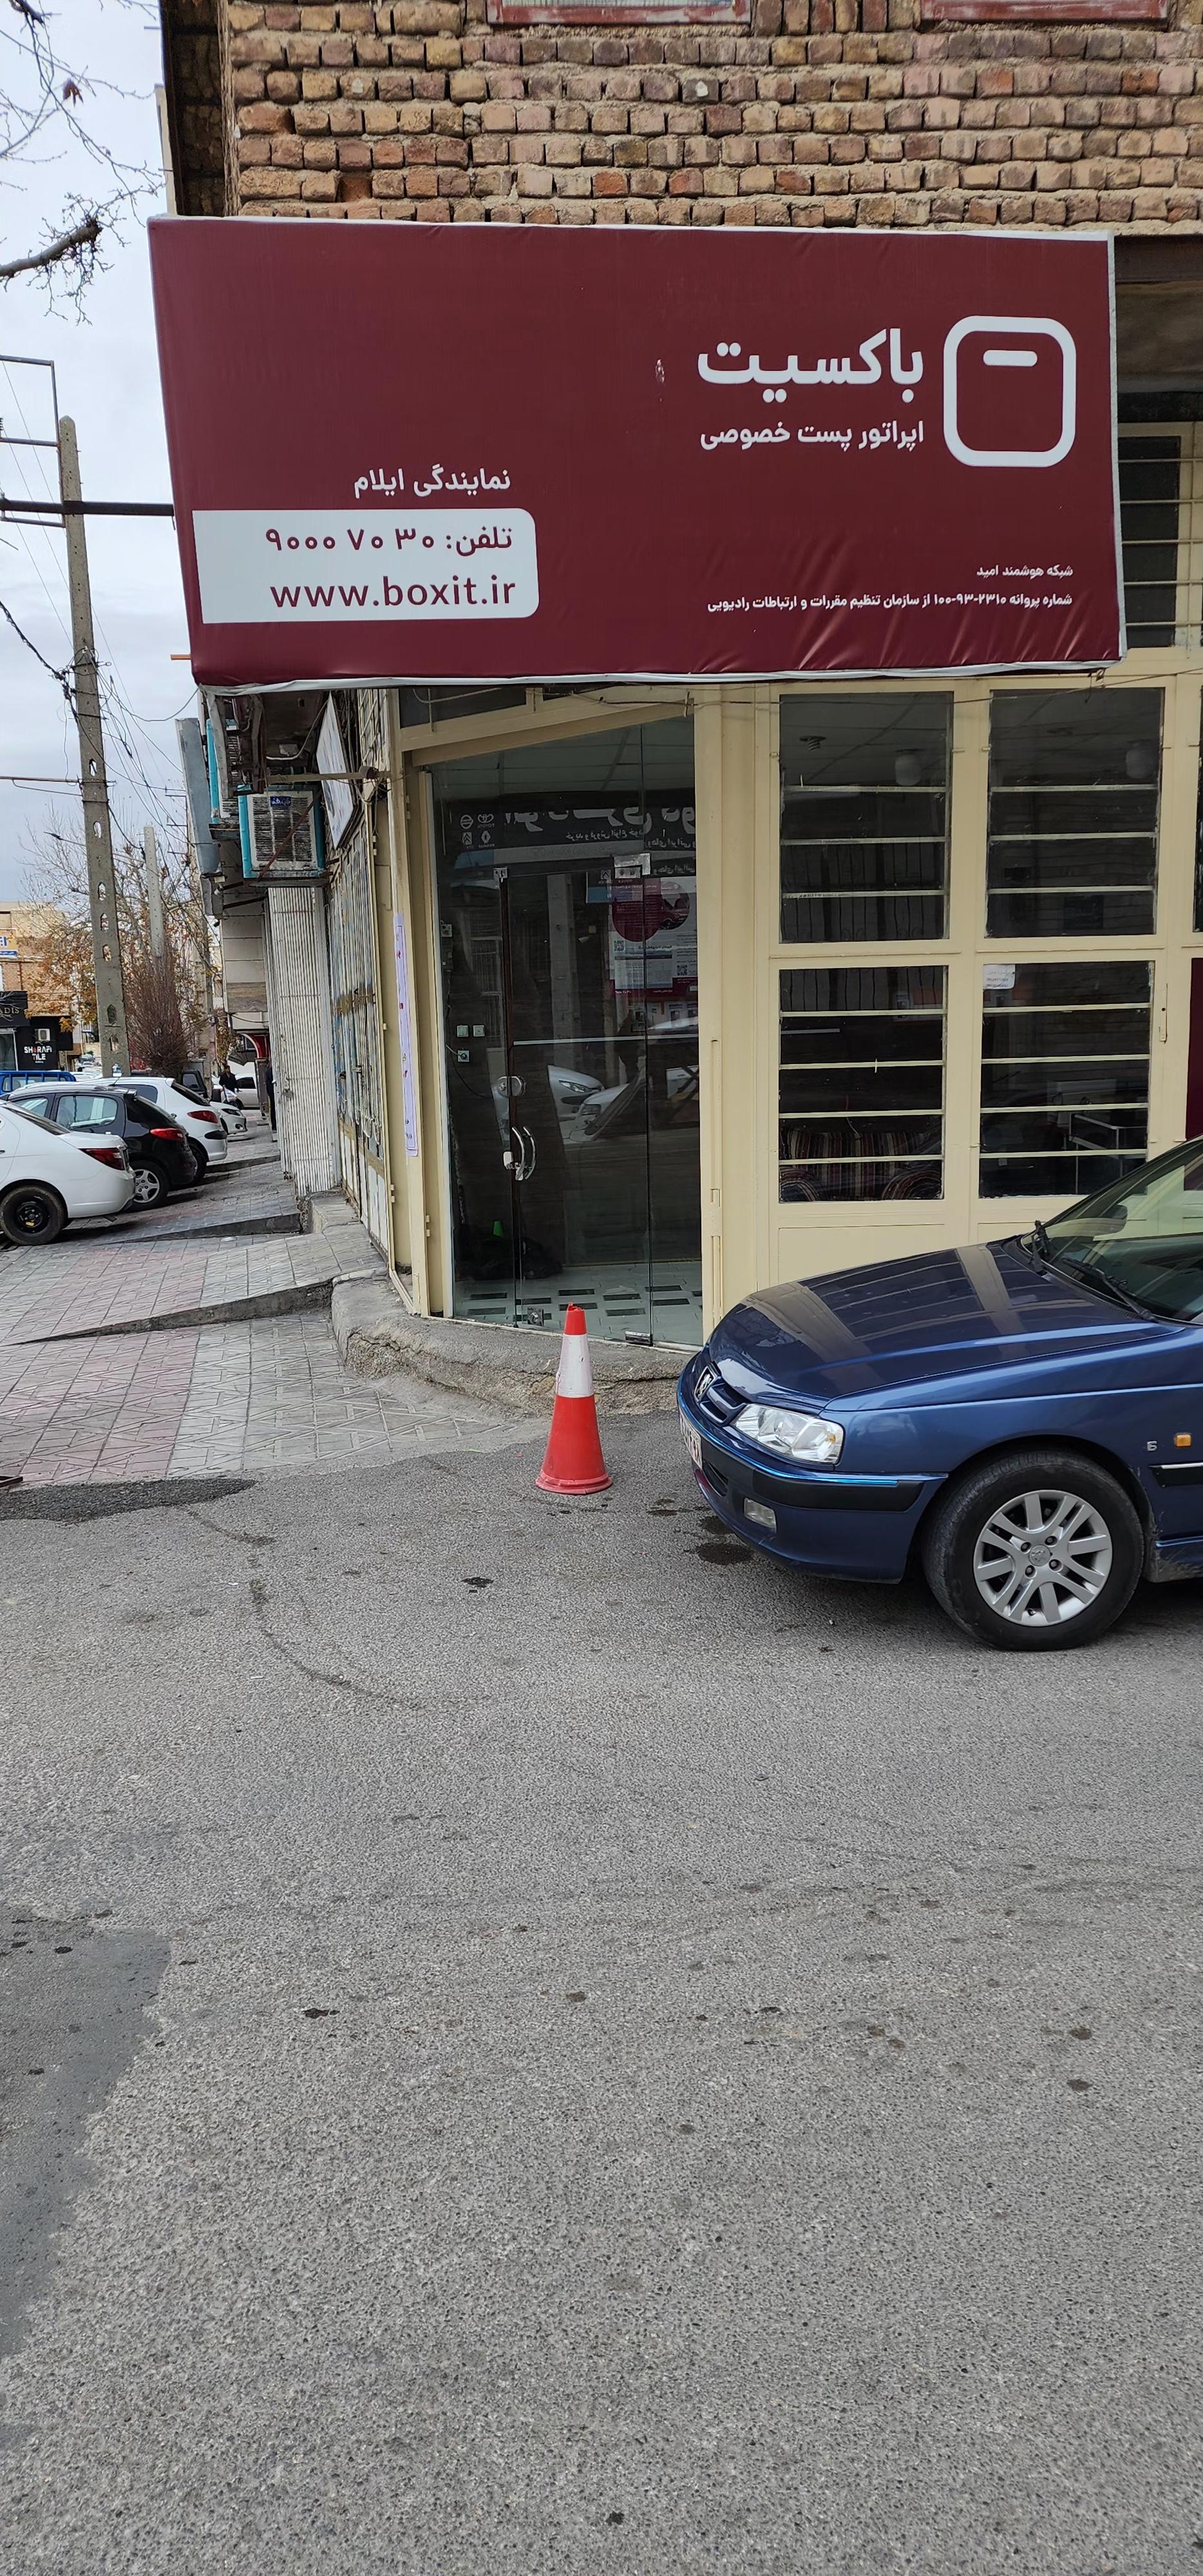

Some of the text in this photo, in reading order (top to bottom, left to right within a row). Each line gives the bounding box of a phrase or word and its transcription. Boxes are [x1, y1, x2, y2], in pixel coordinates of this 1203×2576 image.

[697, 328, 924, 403] باکسیت
[700, 421, 924, 452] اپراتور پست خصوصی
[354, 464, 511, 499] نمایندگی ایلام
[446, 526, 512, 557] تلفن:
[976, 564, 1074, 580] شبکه هوشمند امید
[270, 574, 516, 608] www.boxit.ir
[707, 596, 750, 612] رادیویی
[752, 595, 797, 611] ارتباطات
[800, 599, 808, 611] و
[810, 594, 848, 611] مقررات
[849, 594, 881, 611] تنظیم
[883, 593, 920, 609] سازمان
[922, 593, 931, 609] از
[1009, 593, 1040, 610] پروانه
[1042, 593, 1072, 609] شماره
